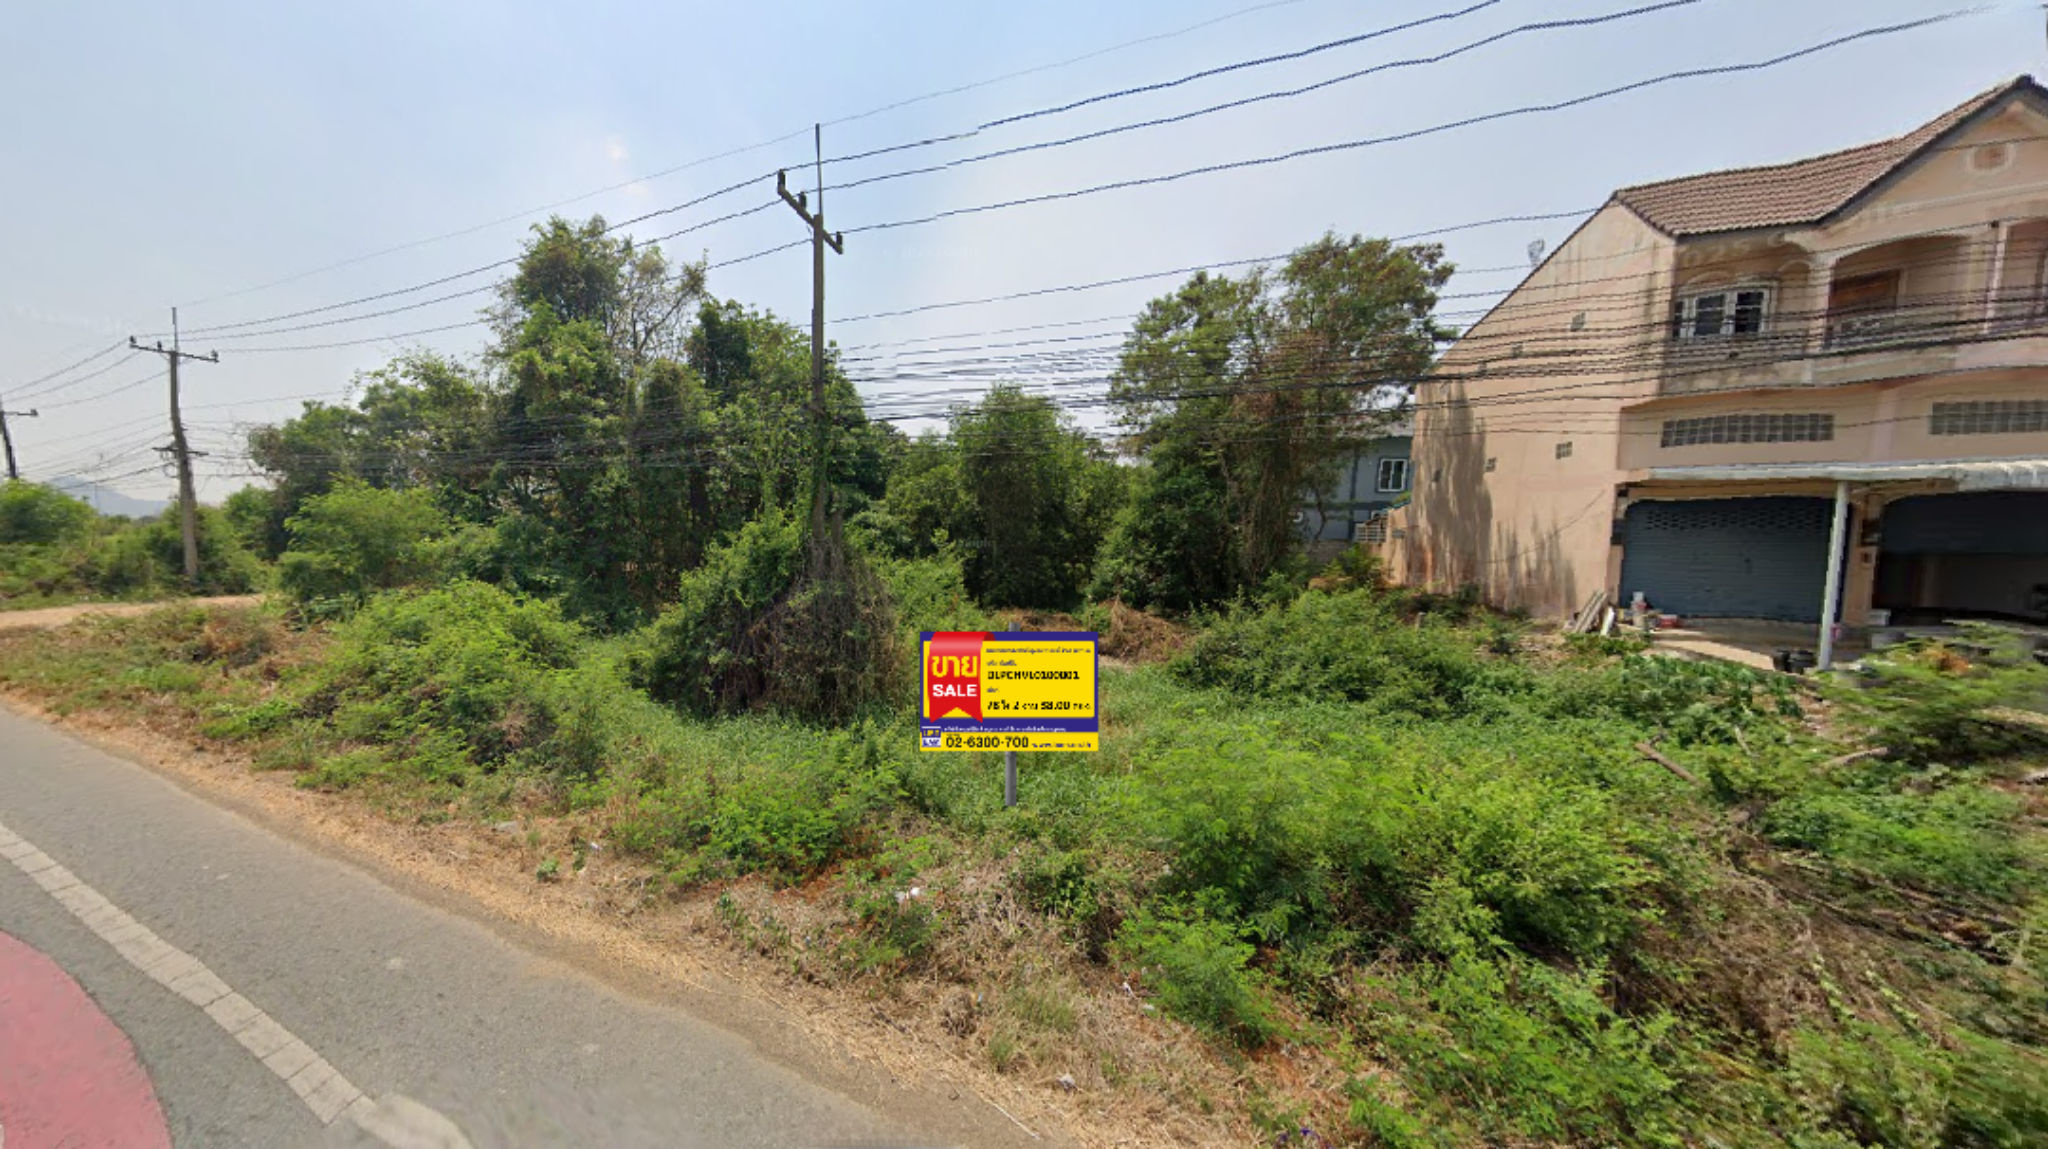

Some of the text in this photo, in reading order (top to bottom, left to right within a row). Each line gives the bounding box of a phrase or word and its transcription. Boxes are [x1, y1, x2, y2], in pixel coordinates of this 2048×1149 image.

[932, 656, 977, 678] ขาย
[932, 684, 977, 697] SALE
[946, 736, 1029, 748] 02-6300-700
